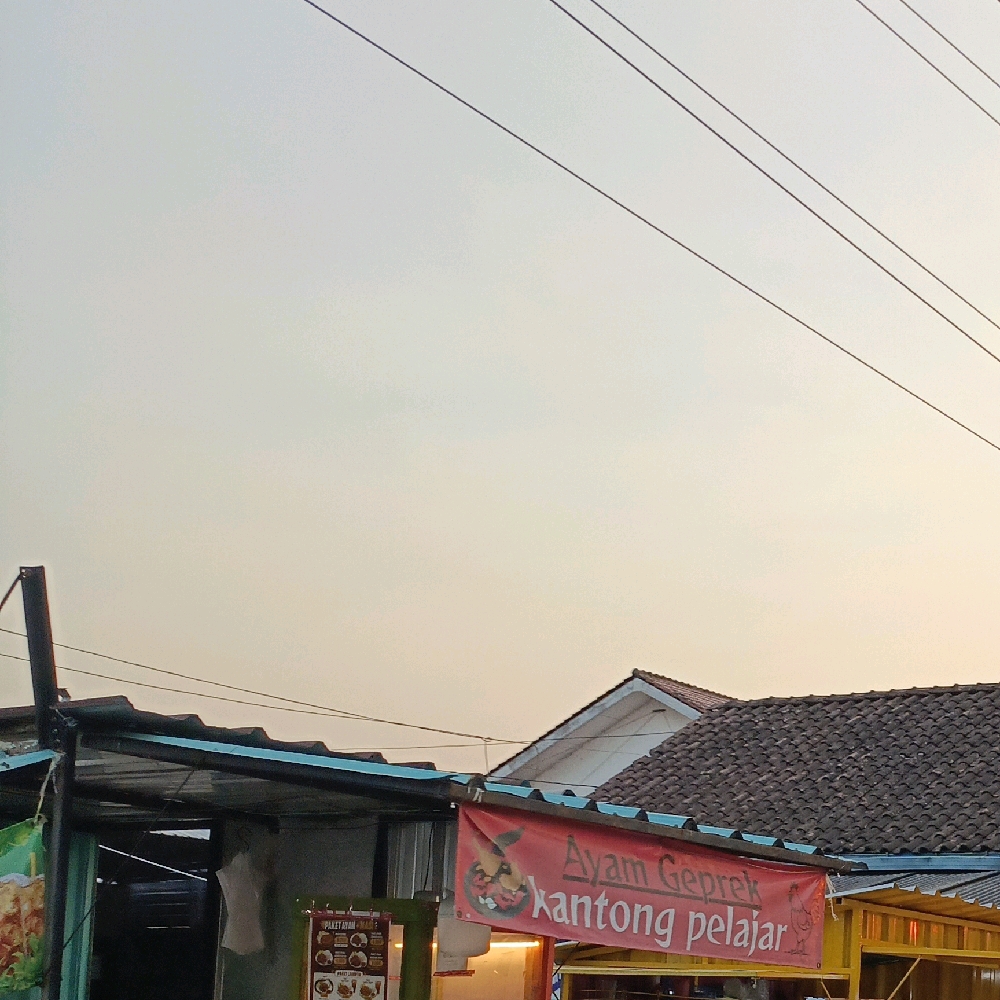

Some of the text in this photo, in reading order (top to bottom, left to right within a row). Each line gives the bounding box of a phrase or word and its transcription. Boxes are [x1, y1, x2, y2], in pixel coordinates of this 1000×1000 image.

[562, 834, 762, 906] Ayam Geprek
[526, 874, 788, 957] kantong pelajar
